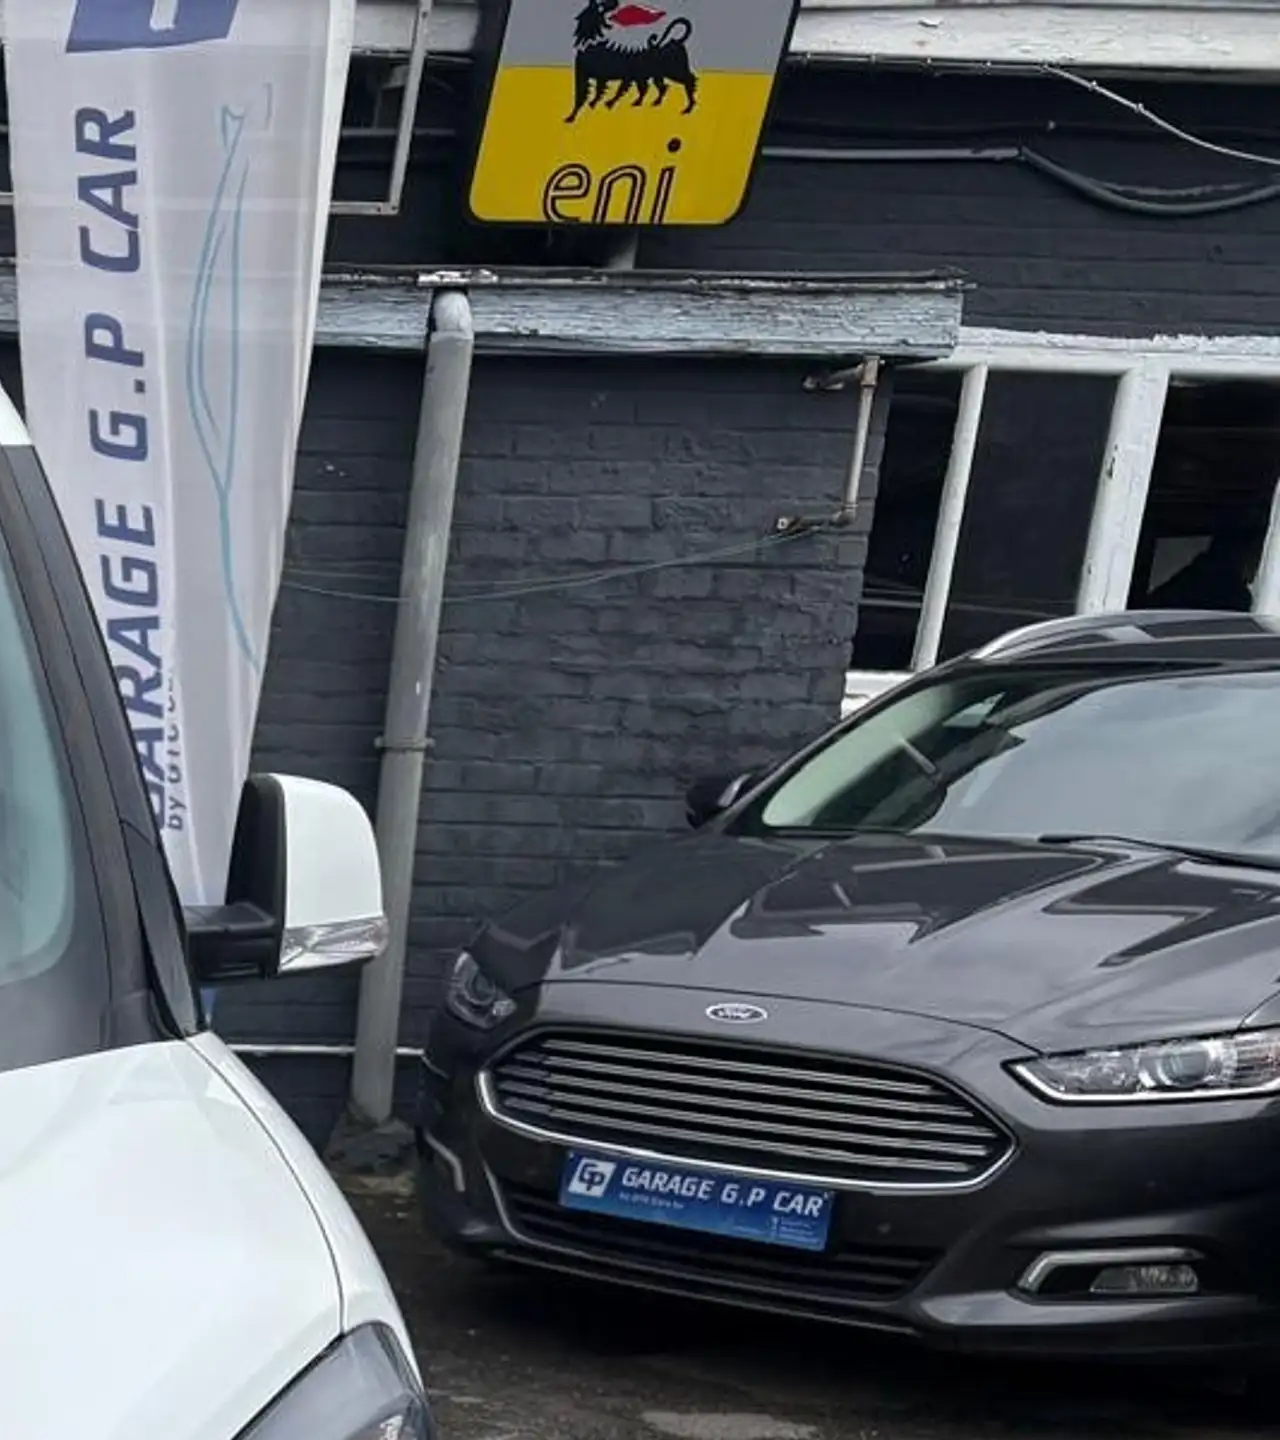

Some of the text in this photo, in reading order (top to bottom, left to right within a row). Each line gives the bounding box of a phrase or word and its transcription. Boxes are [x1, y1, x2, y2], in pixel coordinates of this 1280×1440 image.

[75, 106, 140, 272] CAR
[543, 137, 682, 224] eni
[84, 312, 148, 462] G.P
[621, 1166, 715, 1201] GARAGE
[720, 1183, 766, 1208] G.P
[773, 1191, 824, 1218] CAR
